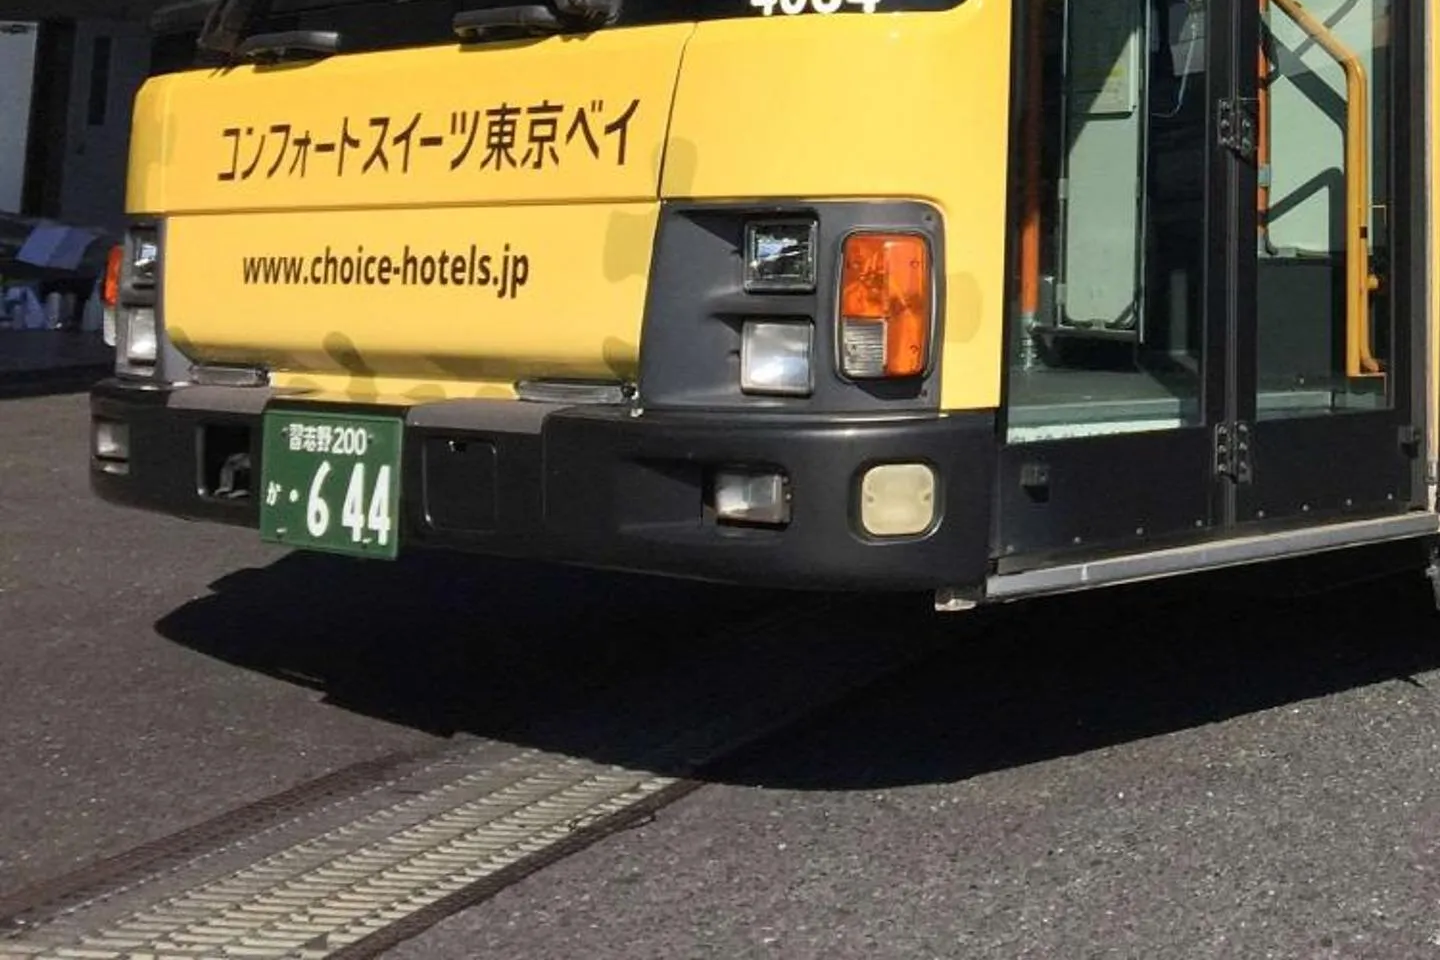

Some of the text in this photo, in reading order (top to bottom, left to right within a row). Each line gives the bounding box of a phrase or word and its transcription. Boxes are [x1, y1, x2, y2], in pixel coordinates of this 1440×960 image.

[217, 98, 641, 182] コンフォートスイーツ東京ベイ
[242, 243, 530, 299] www.choice-hotels.jp
